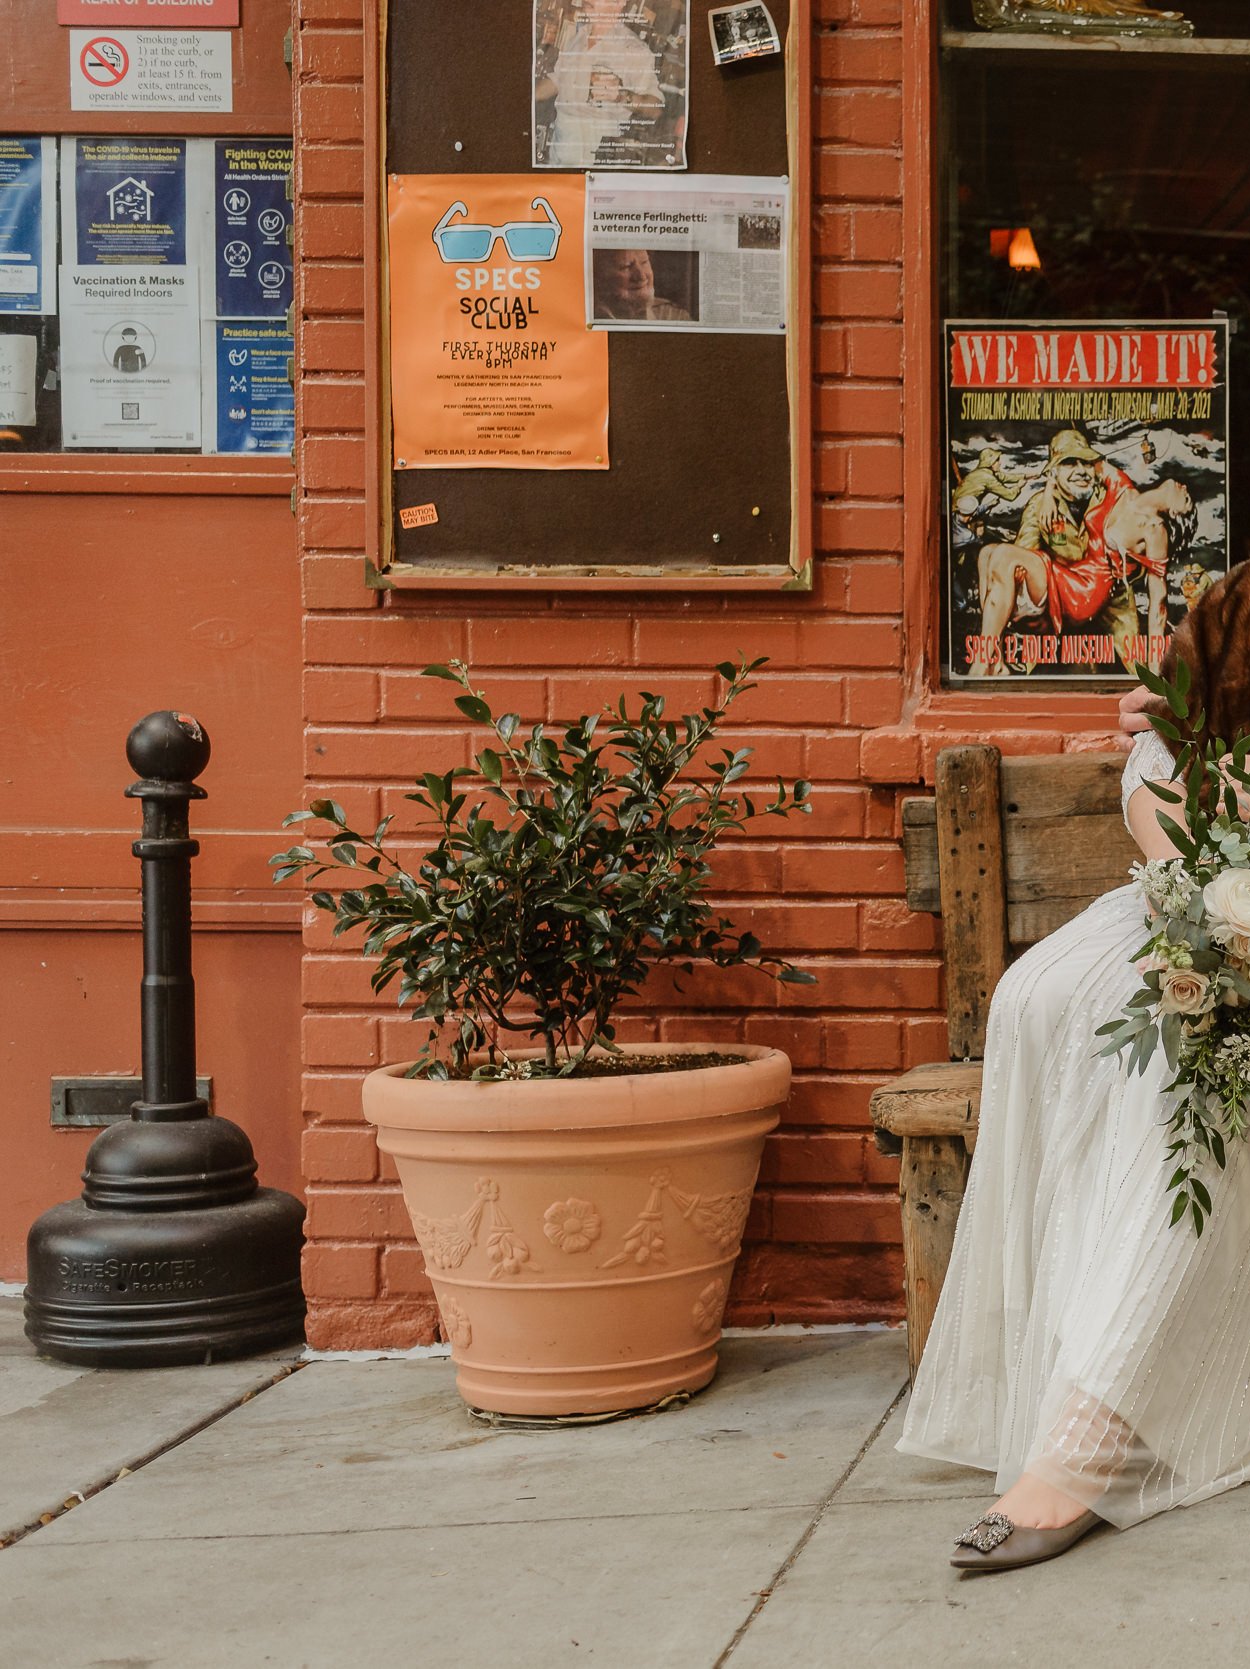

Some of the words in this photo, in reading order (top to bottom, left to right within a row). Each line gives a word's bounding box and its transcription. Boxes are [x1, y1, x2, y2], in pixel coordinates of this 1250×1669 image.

[136, 34, 178, 46] Smoking
[180, 34, 201, 47] only
[138, 46, 148, 56] 1)
[150, 47, 158, 56] at
[161, 46, 175, 56] the
[178, 46, 201, 57] curb,
[204, 48, 214, 56] or
[138, 57, 148, 68] 2)
[150, 57, 158, 67] if
[160, 59, 172, 67] no
[174, 57, 198, 68] curb,
[138, 70, 146, 78] at
[149, 69, 170, 79] least
[173, 69, 184, 79] 15
[187, 69, 197, 79] ft.
[200, 69, 222, 79] from
[138, 81, 162, 91] exits,
[165, 82, 211, 91] entrances,
[88, 91, 128, 103] operable
[131, 92, 175, 102] windows,
[178, 92, 195, 102] and
[198, 93, 222, 103] vents
[82, 145, 95, 153] The
[96, 145, 129, 154] COVID-19
[130, 146, 147, 154] virus
[173, 147, 181, 155] in
[225, 149, 266, 160] Fighting
[229, 160, 239, 170] in
[240, 160, 257, 170] the
[593, 211, 641, 222] Lawrence
[643, 211, 708, 224] Ferlinghetti:
[592, 225, 599, 233] a
[601, 224, 640, 233] veteran
[642, 224, 658, 233] for
[659, 226, 690, 235] peace
[72, 275, 137, 286] Vaccination
[139, 276, 146, 286] &
[149, 275, 185, 286] Masks
[455, 267, 541, 291] SPECS
[85, 287, 131, 300] Required
[133, 287, 173, 299] Indoors
[459, 297, 540, 315] SOCIAL
[471, 311, 529, 330] CLUB
[223, 327, 259, 338] Practice
[259, 328, 277, 337] safe
[442, 341, 478, 352] FIRST
[486, 341, 558, 352] THURSDAY
[451, 350, 492, 360] EVERY
[500, 350, 548, 361] MONTH
[958, 334, 1019, 385] WE
[1032, 333, 1143, 384] MADE
[1155, 333, 1208, 384] IT!
[485, 358, 513, 369] 8PM
[960, 391, 1008, 421] STUMBLING
[1009, 391, 1041, 421] ASHORE
[1043, 391, 1051, 421] IN
[1053, 391, 1081, 421] NORTH
[1156, 391, 1176, 421] MAY
[1192, 391, 1212, 421] 2021
[401, 507, 434, 519] CAUTION
[403, 517, 418, 526] MAY
[420, 513, 435, 523] BITE
[965, 634, 1001, 665] SPECS
[1021, 634, 1058, 664] ADLER
[1060, 634, 1116, 664] MUSEUM
[1122, 634, 1148, 665] SAN
[62, 1279, 111, 1294] Cigarette
[132, 1278, 205, 1293] Receptacle
